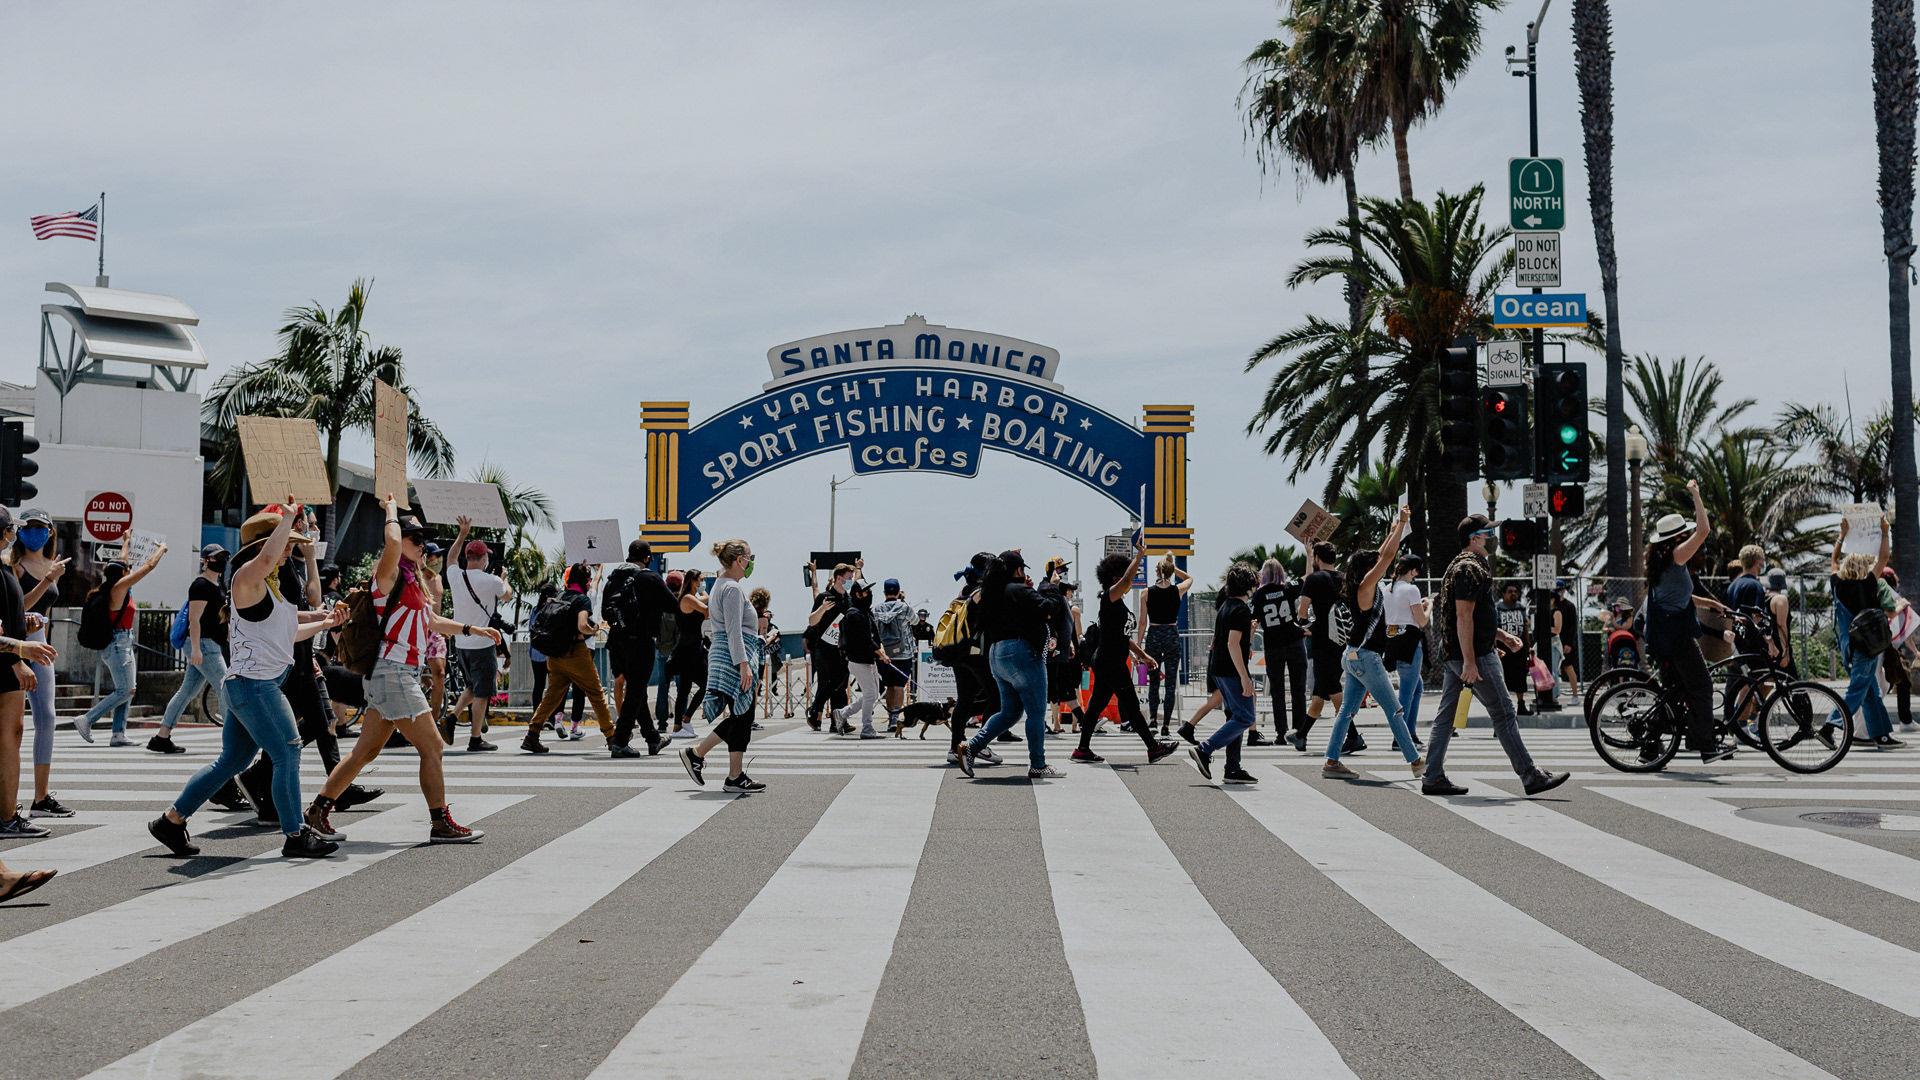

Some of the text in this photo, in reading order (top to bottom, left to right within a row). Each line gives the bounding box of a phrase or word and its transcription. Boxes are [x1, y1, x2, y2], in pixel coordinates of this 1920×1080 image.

[1533, 171, 1540, 188] 1
[1513, 196, 1561, 210] NORTH
[1518, 239, 1557, 252] DO NOT
[1518, 257, 1558, 270] BLOCK
[1518, 273, 1559, 283] INTERSECTION
[1501, 298, 1580, 318] Ocean
[779, 332, 1047, 379] SANTA MONICA
[1489, 369, 1520, 380] SIGNAL
[762, 376, 1069, 425] YACHT HARBOR
[702, 405, 1122, 490] SPORT FISHING BOATING
[92, 501, 127, 510] DO NOT
[1524, 502, 1534, 514] OK
[1293, 511, 1308, 528] NO
[93, 523, 122, 533] ENTER
[103, 549, 111, 557] ONE
[1262, 600, 1293, 628] 24
